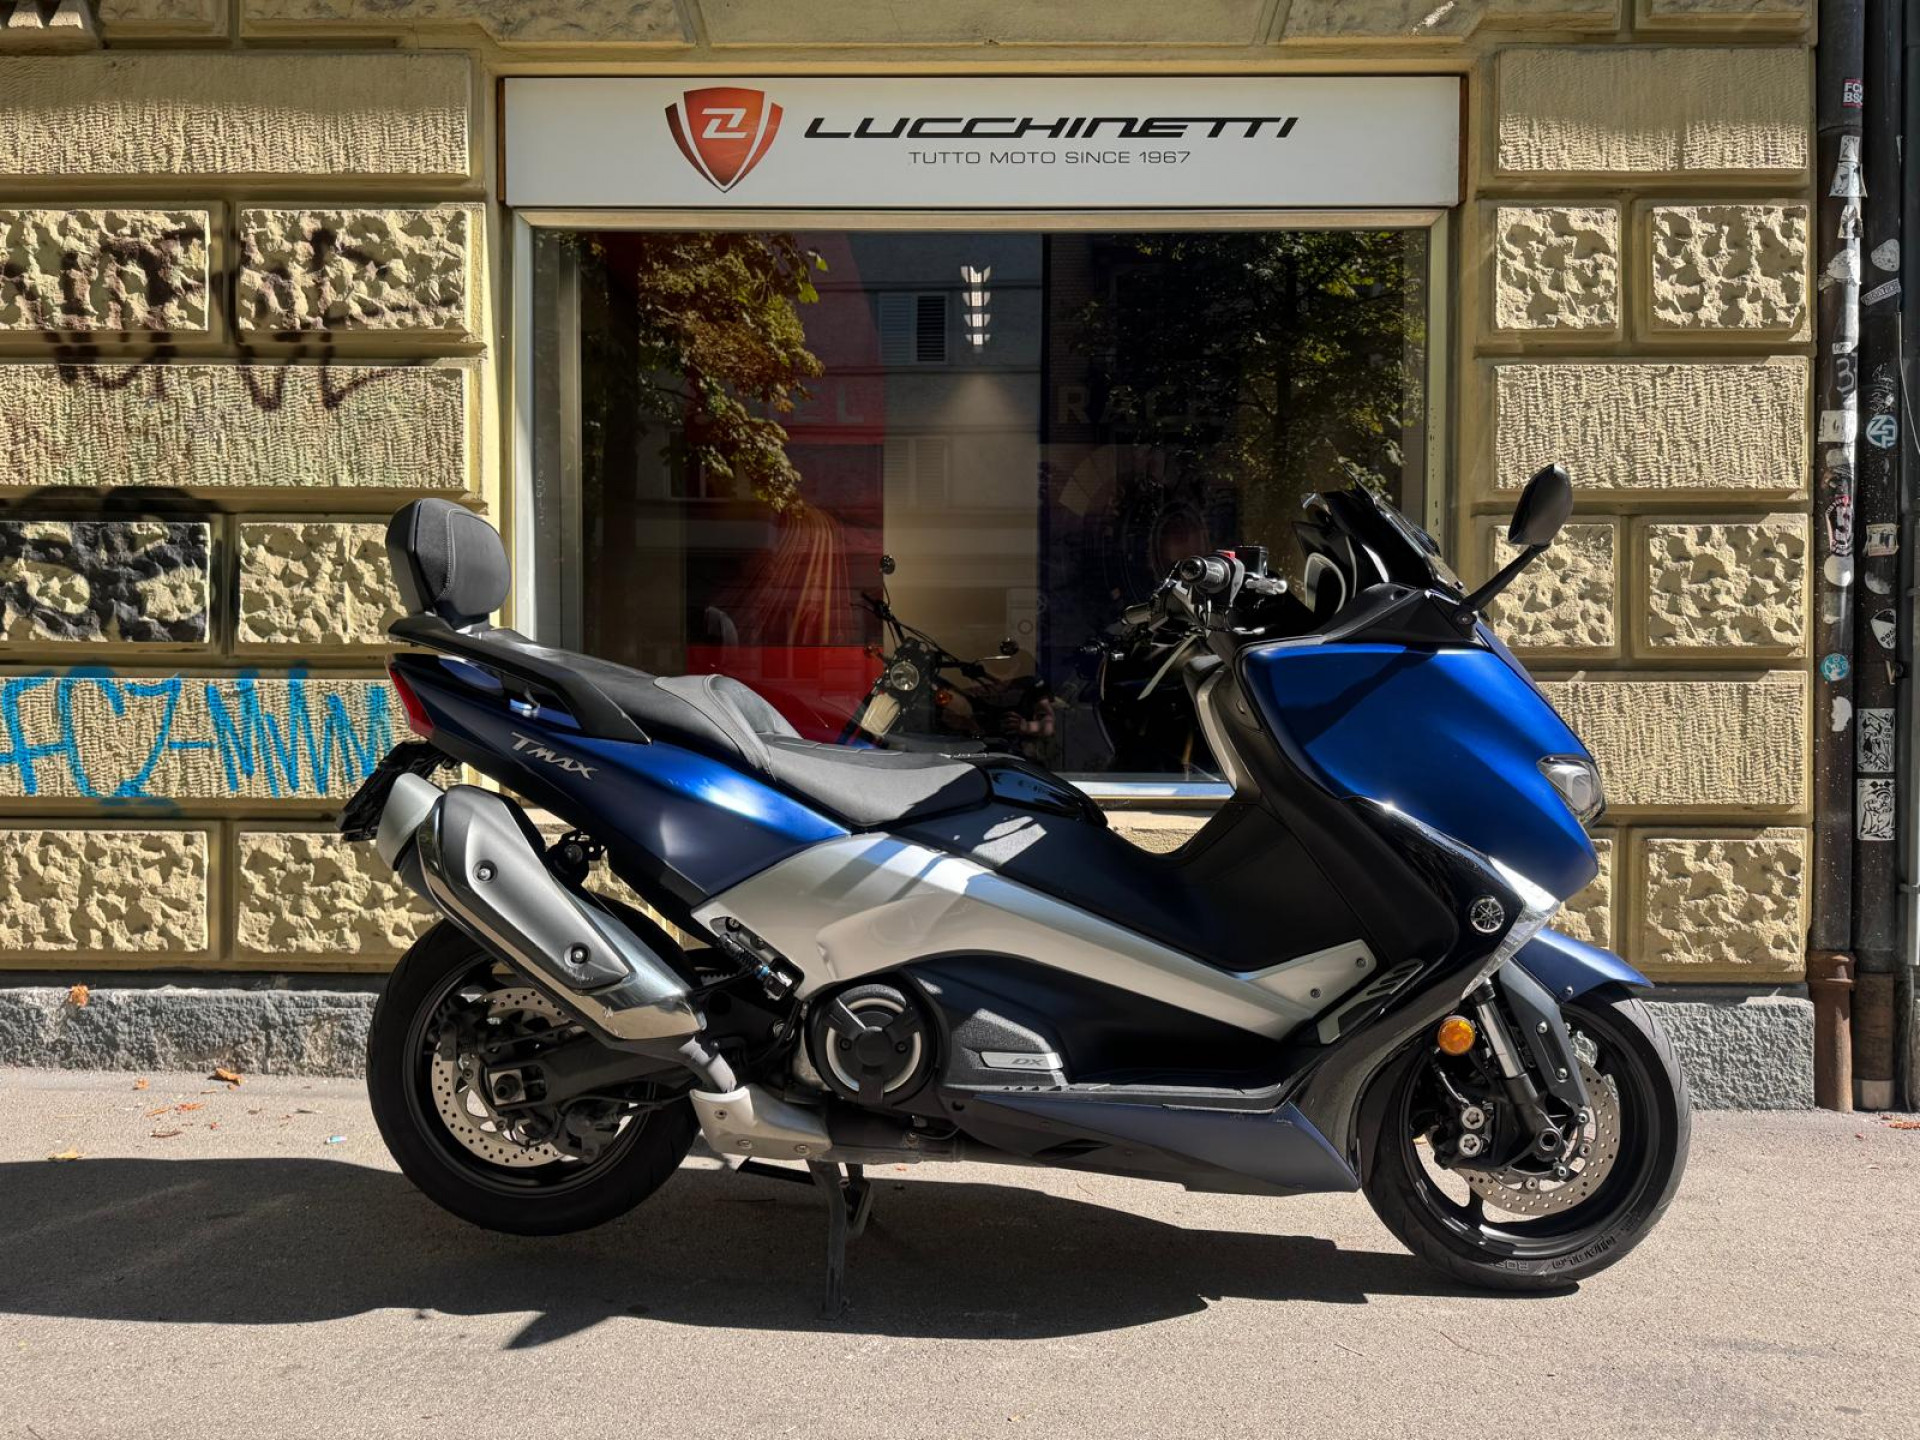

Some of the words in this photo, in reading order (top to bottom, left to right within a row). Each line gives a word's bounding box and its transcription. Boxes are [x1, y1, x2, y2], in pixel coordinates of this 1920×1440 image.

[804, 117, 1299, 138] LUCCHINETTI
[908, 151, 981, 164] TUTTO
[990, 151, 1056, 164] MOTO
[1065, 151, 1130, 164] SINCE
[1138, 151, 1191, 164] 1967
[511, 731, 599, 780] TMAX
[1012, 1058, 1043, 1066] DX
